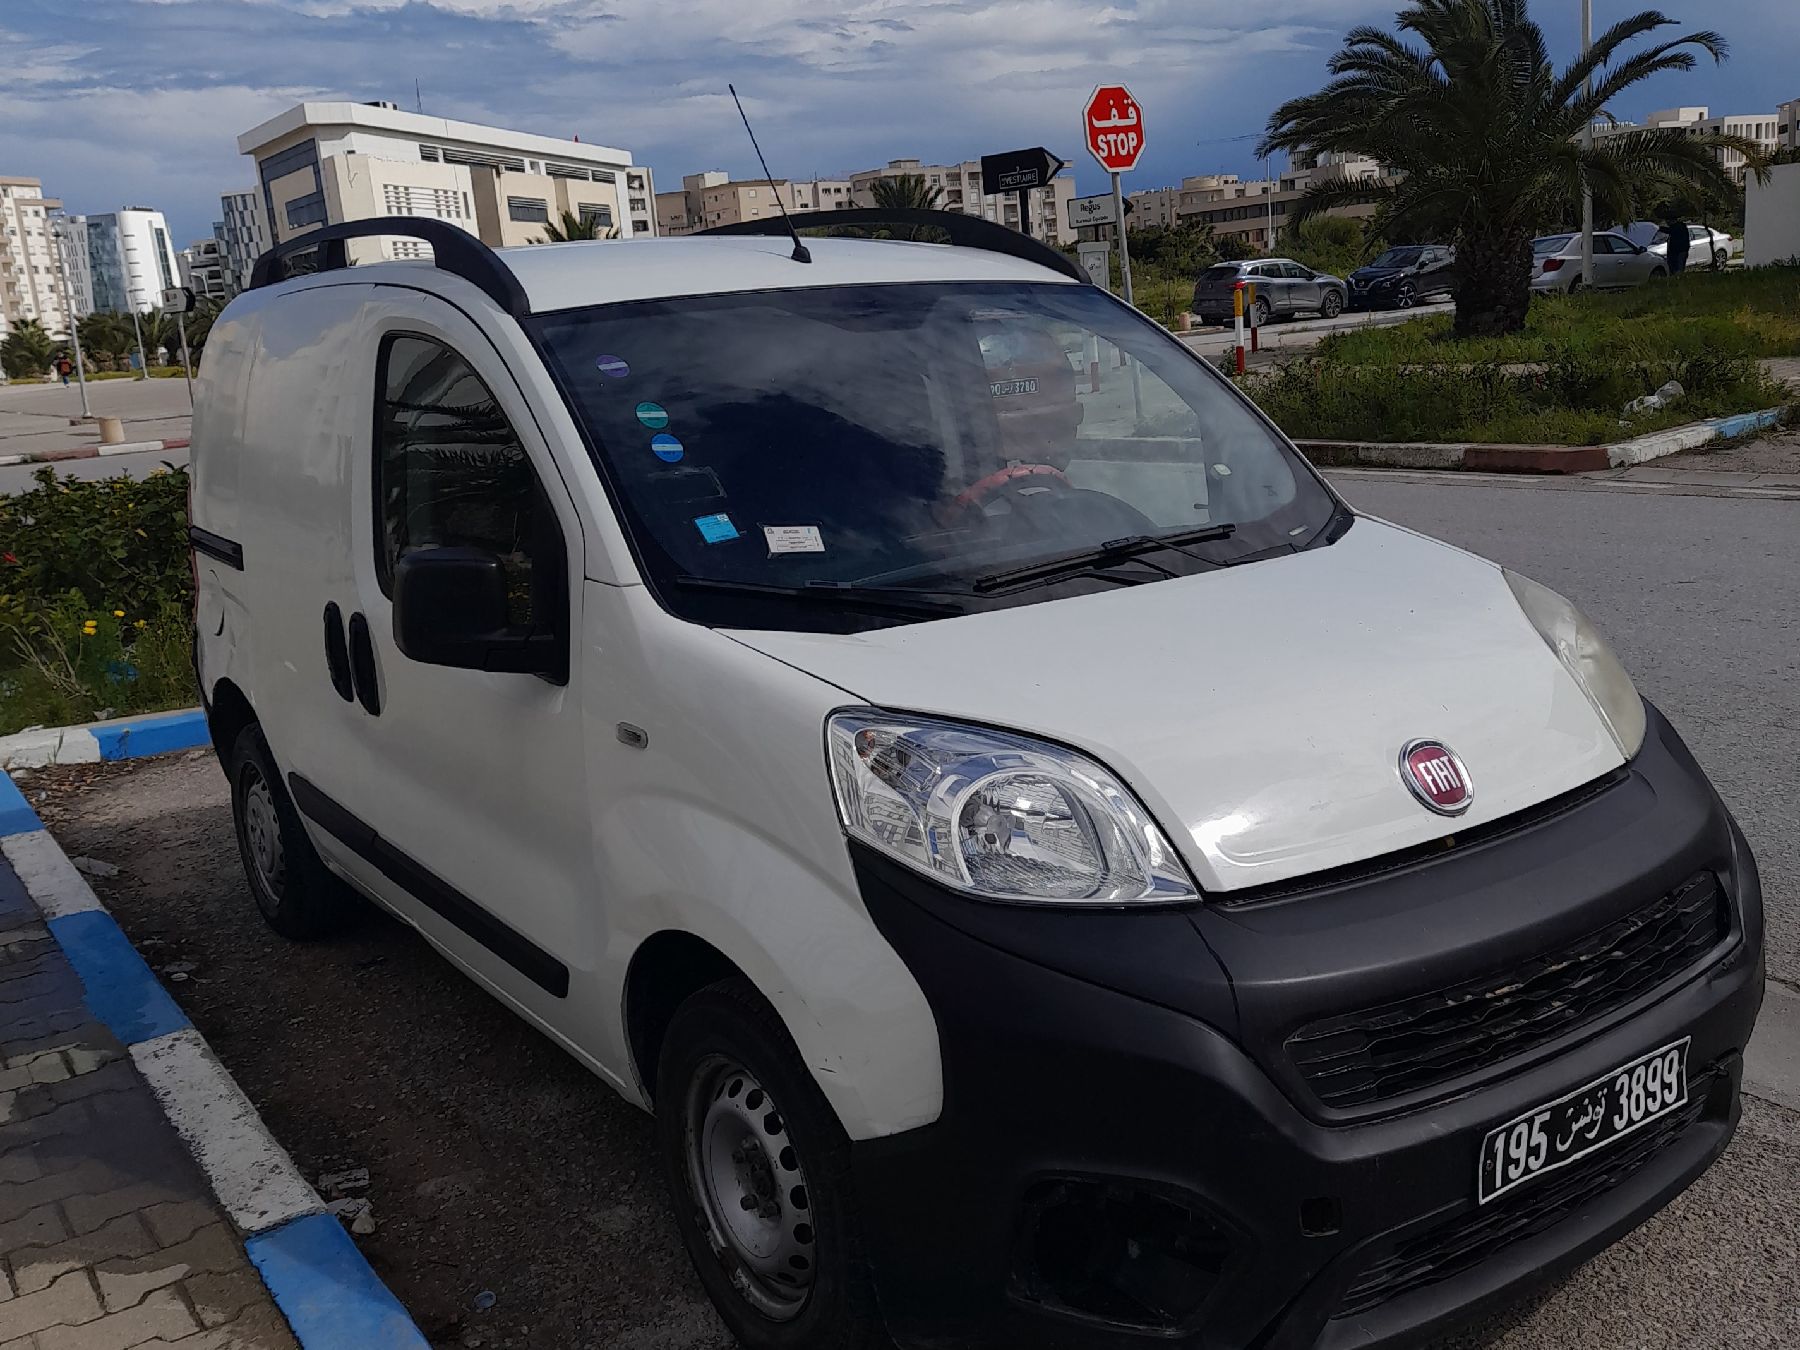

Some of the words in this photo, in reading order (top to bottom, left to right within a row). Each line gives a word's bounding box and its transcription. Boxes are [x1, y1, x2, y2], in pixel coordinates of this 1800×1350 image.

[1092, 97, 1137, 128] قف
[1097, 132, 1138, 158] STOP
[1417, 755, 1461, 795] FIAT
[1494, 1111, 1551, 1189] 195
[1556, 1088, 1608, 1152] تونس
[1613, 1050, 1679, 1131] 3899
